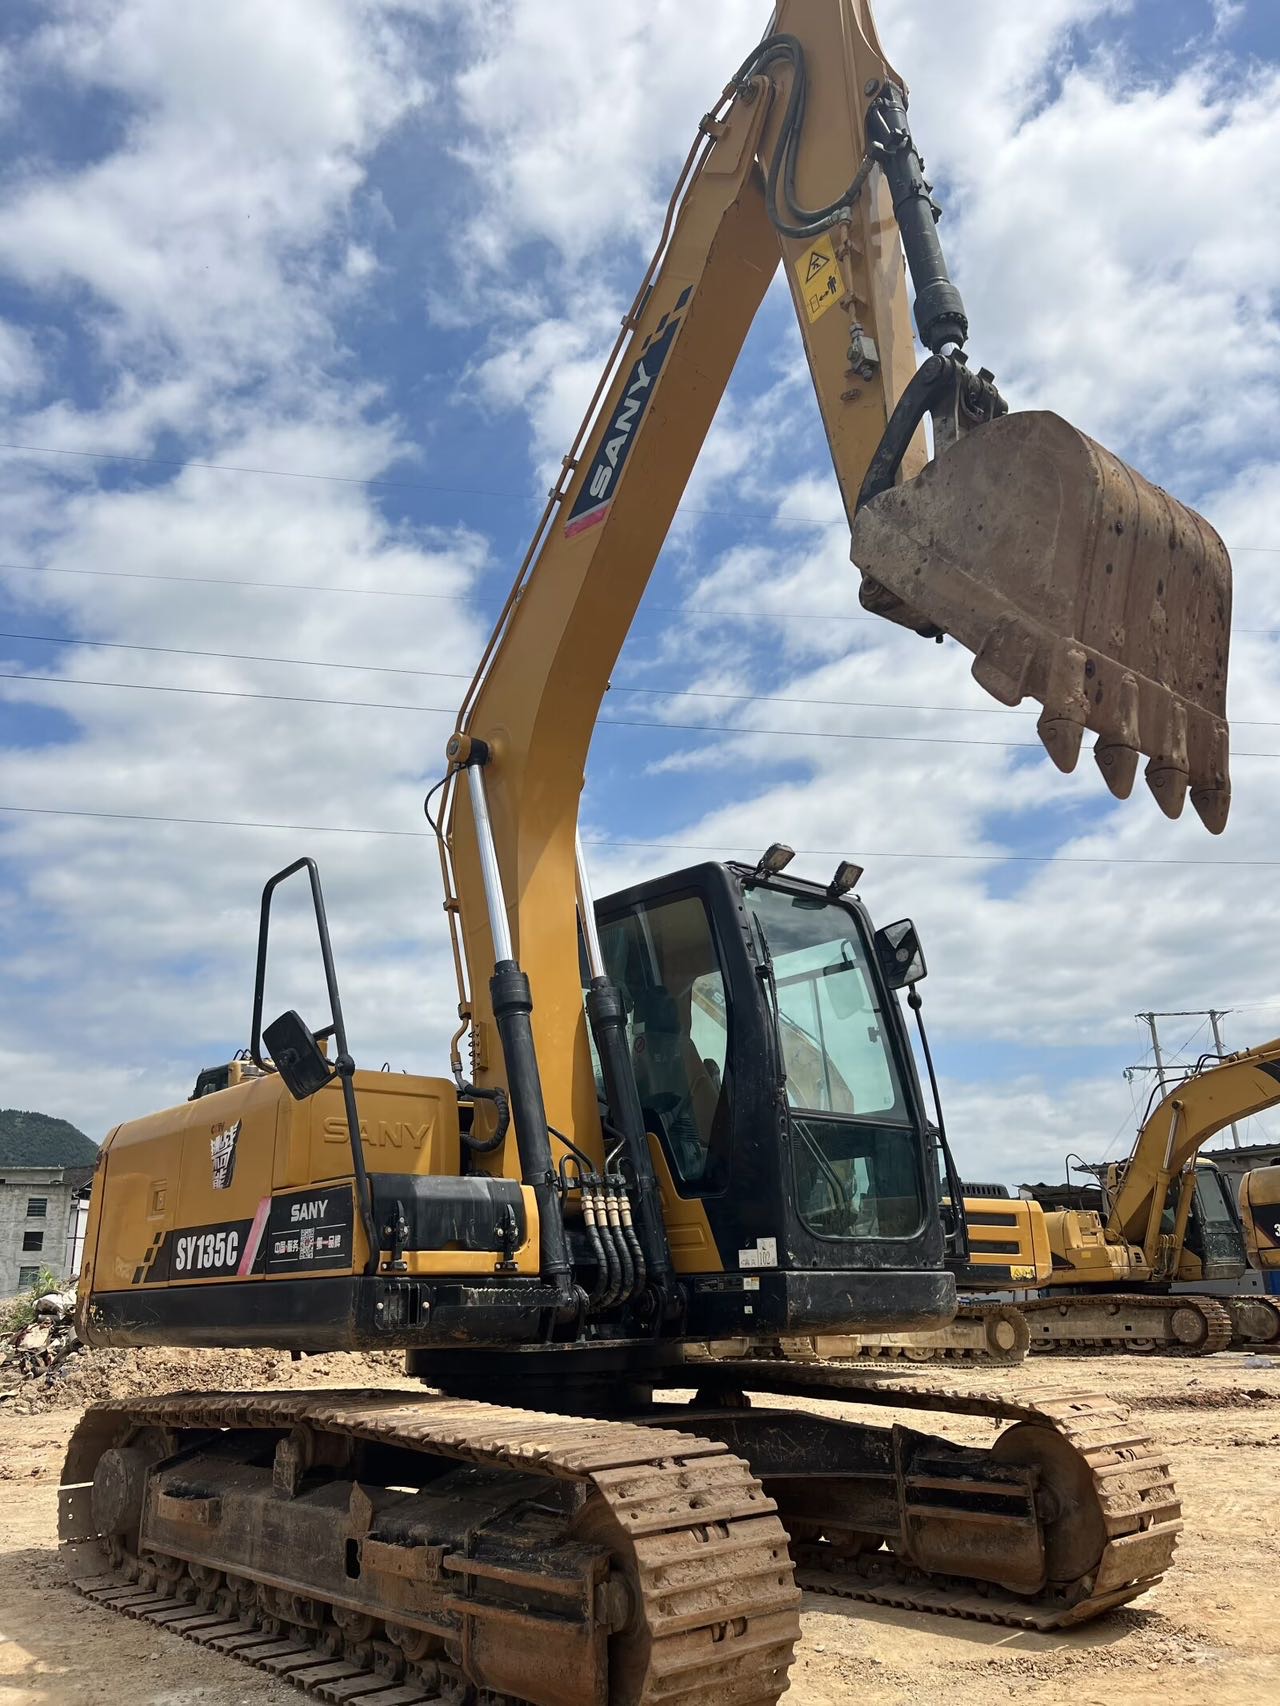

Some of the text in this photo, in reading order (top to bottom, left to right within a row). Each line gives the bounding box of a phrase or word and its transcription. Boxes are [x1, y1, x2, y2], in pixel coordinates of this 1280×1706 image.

[590, 361, 651, 498] SANY
[290, 1199, 329, 1223] SANY
[175, 1230, 239, 1271] SY135C
